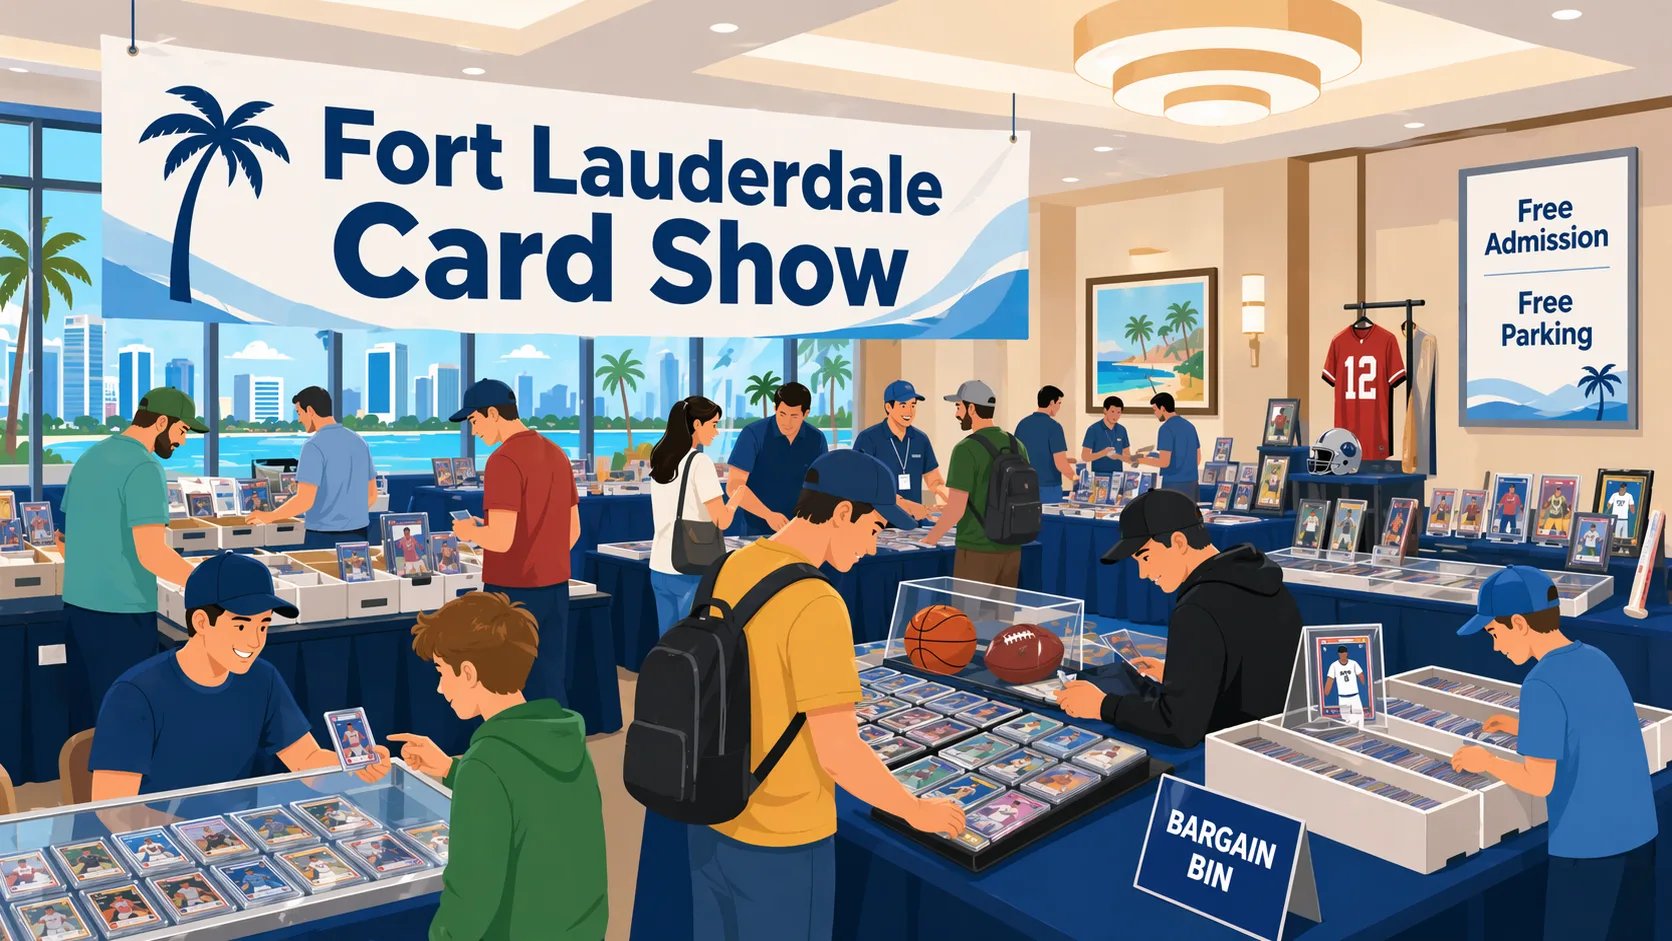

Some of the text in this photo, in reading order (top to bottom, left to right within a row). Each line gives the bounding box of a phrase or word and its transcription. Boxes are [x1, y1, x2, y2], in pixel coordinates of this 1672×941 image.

[323, 106, 944, 218] Fort Lauderdale
[1518, 198, 1573, 223] Free
[332, 201, 910, 308] Card Show
[1484, 224, 1609, 256] Admission
[1519, 290, 1573, 315] Free
[1502, 320, 1593, 351] Parking
[1344, 355, 1377, 400] 12
[1166, 808, 1277, 870] BARGAIN
[1186, 852, 1234, 893] BIN
